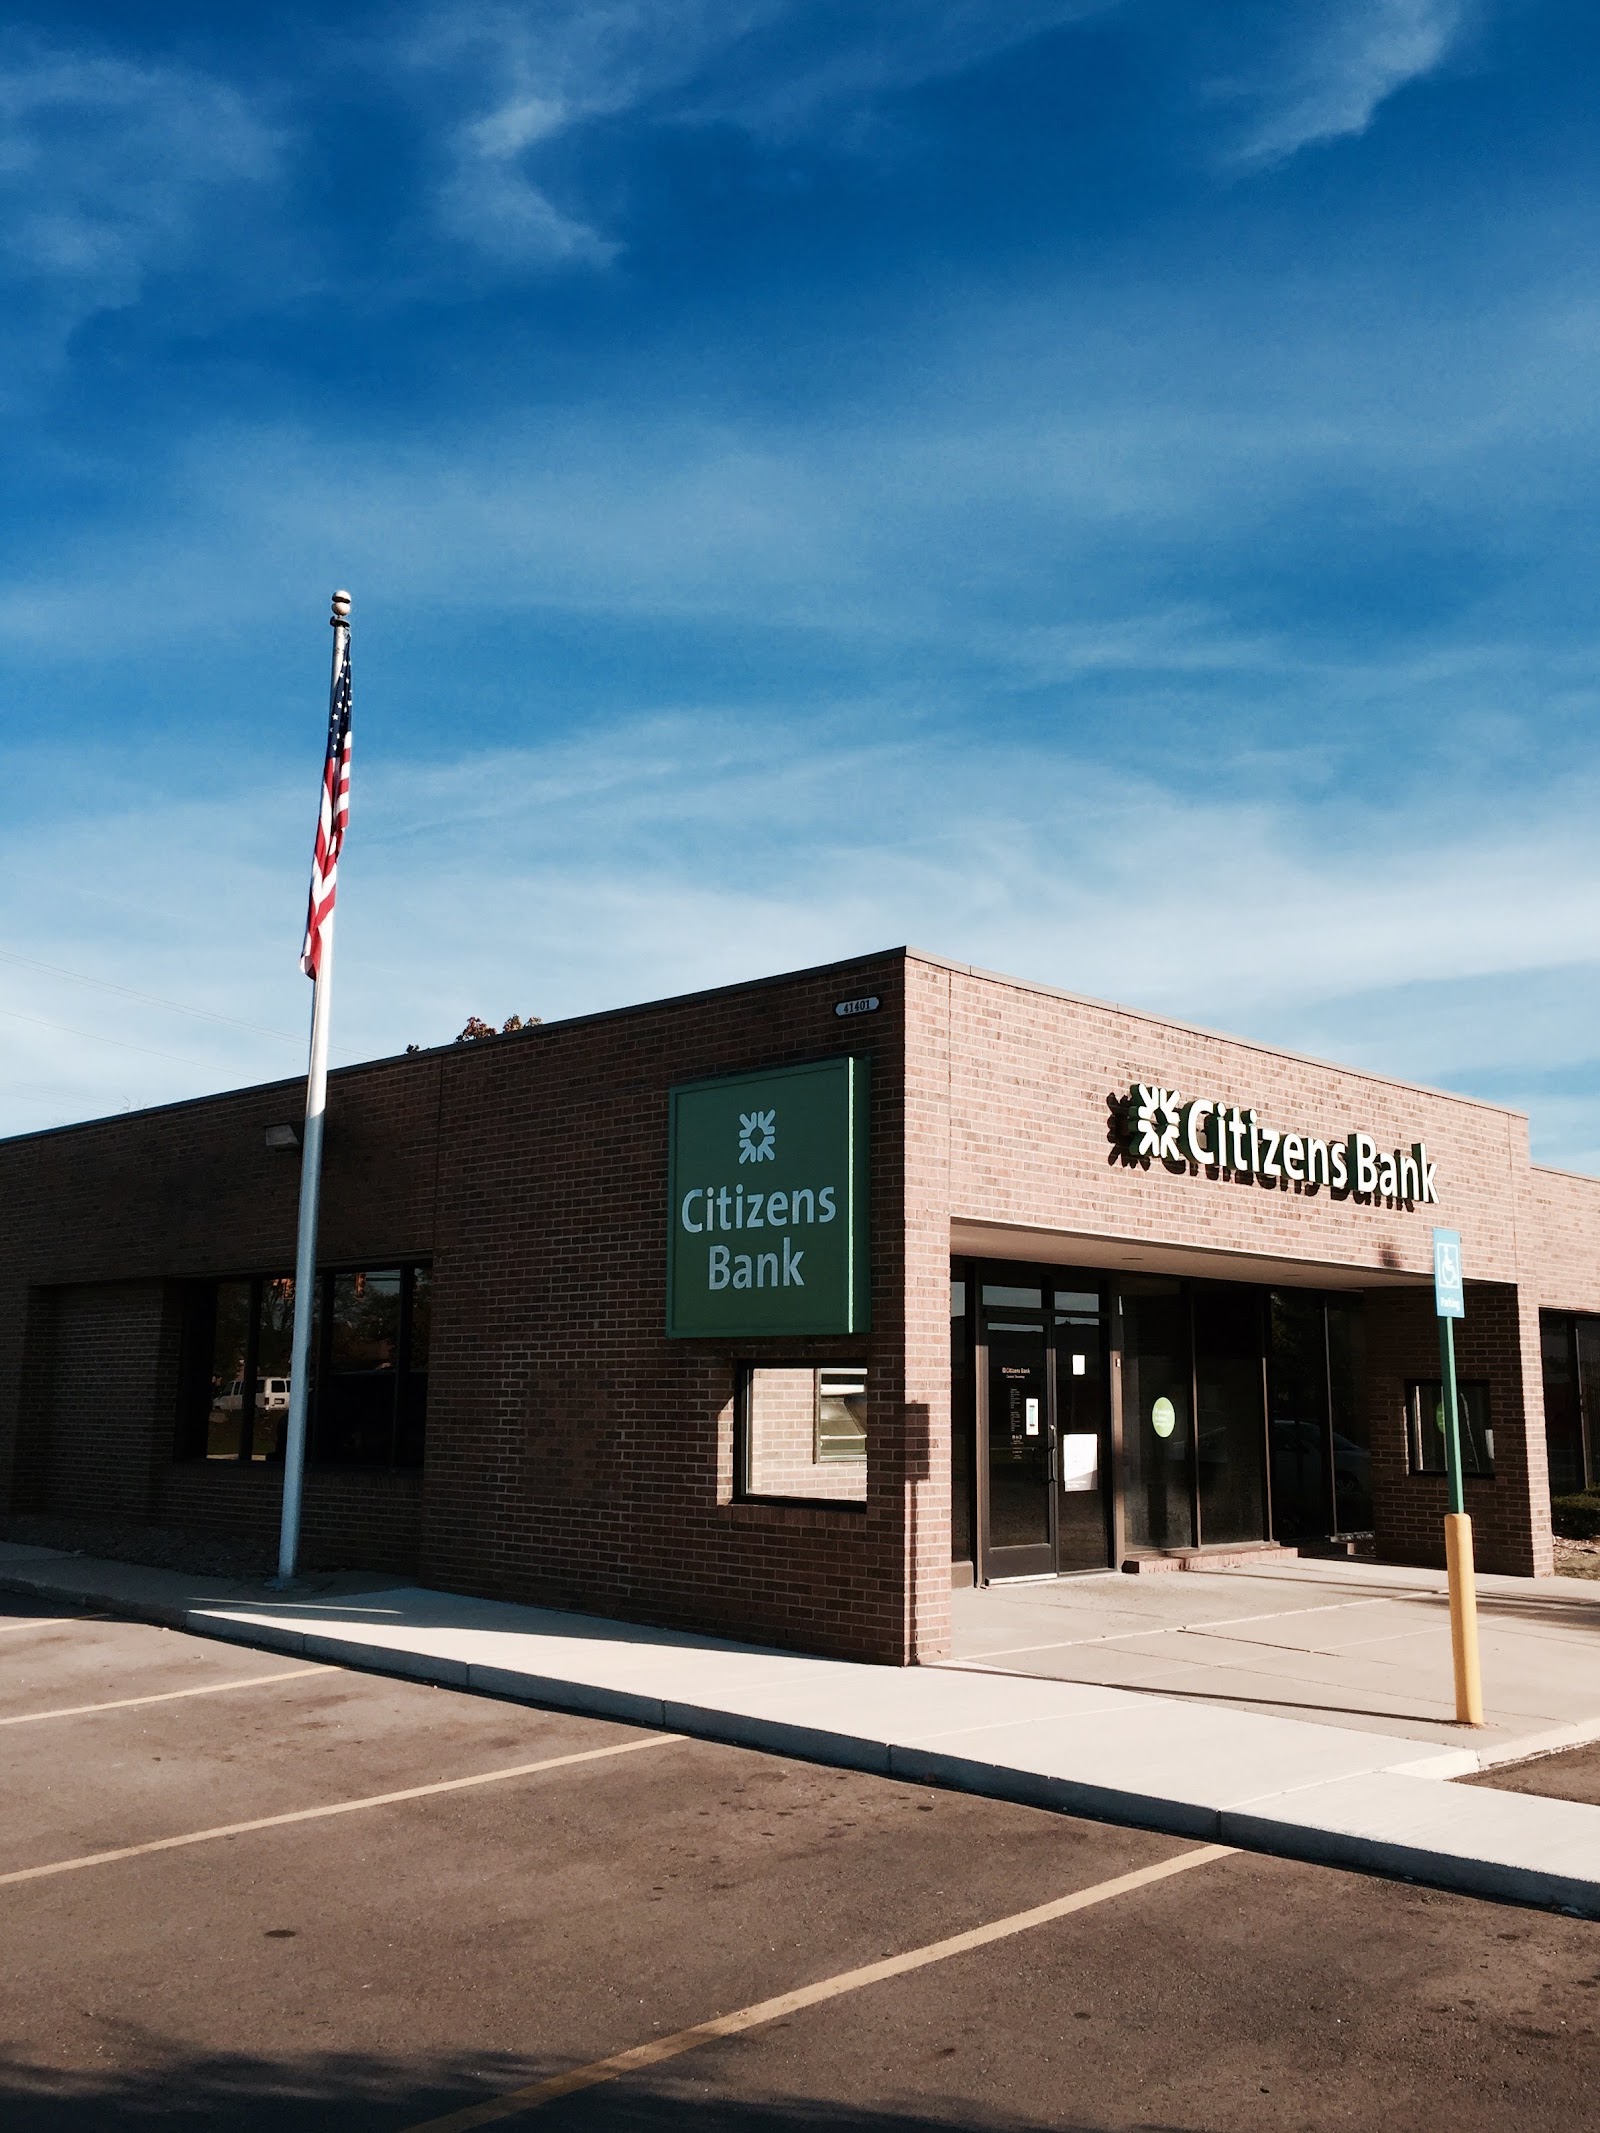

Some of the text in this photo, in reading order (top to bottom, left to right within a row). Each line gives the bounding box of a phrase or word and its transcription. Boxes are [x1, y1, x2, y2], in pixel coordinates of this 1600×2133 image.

[843, 999, 870, 1014] 41401
[1184, 1099, 1440, 1204] Citizens Bank
[681, 1183, 837, 1233] Citizens
[708, 1236, 805, 1291] Bank
[1440, 1296, 1461, 1312] Parking
